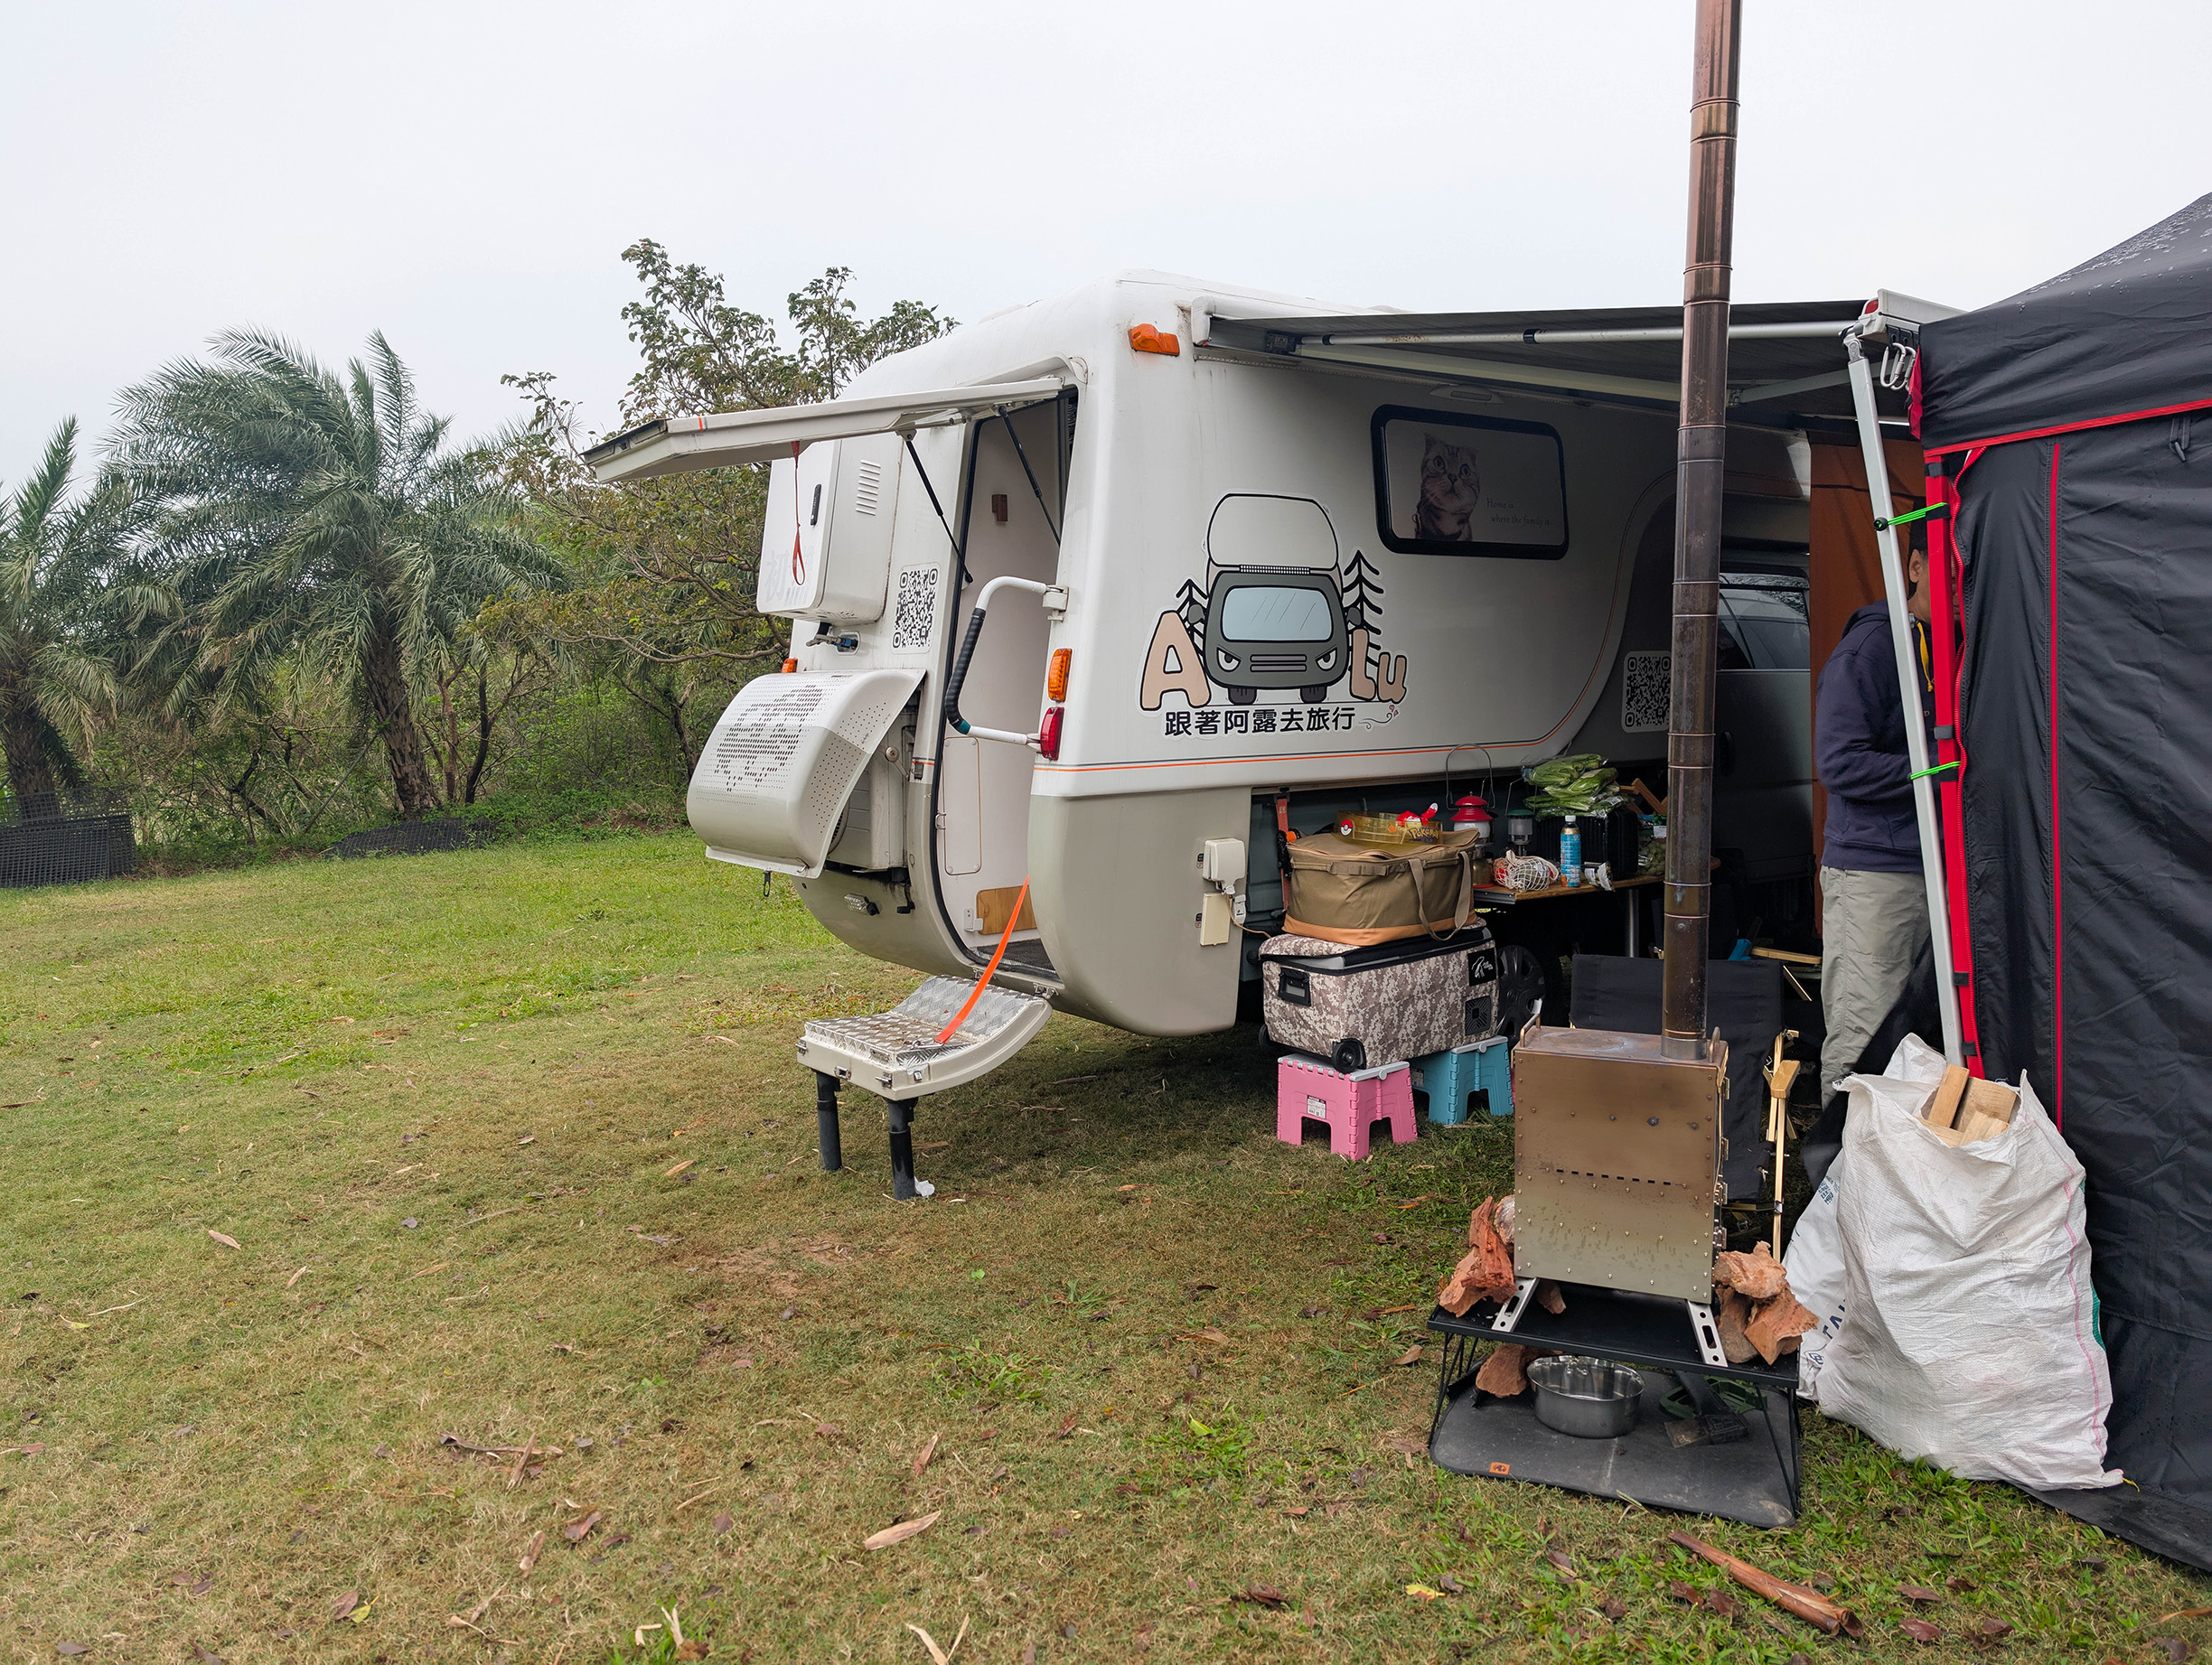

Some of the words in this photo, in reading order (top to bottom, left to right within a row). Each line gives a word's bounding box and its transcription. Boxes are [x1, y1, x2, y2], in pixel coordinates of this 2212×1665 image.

[1165, 706, 1355, 736] 跟著阿露去旅行
